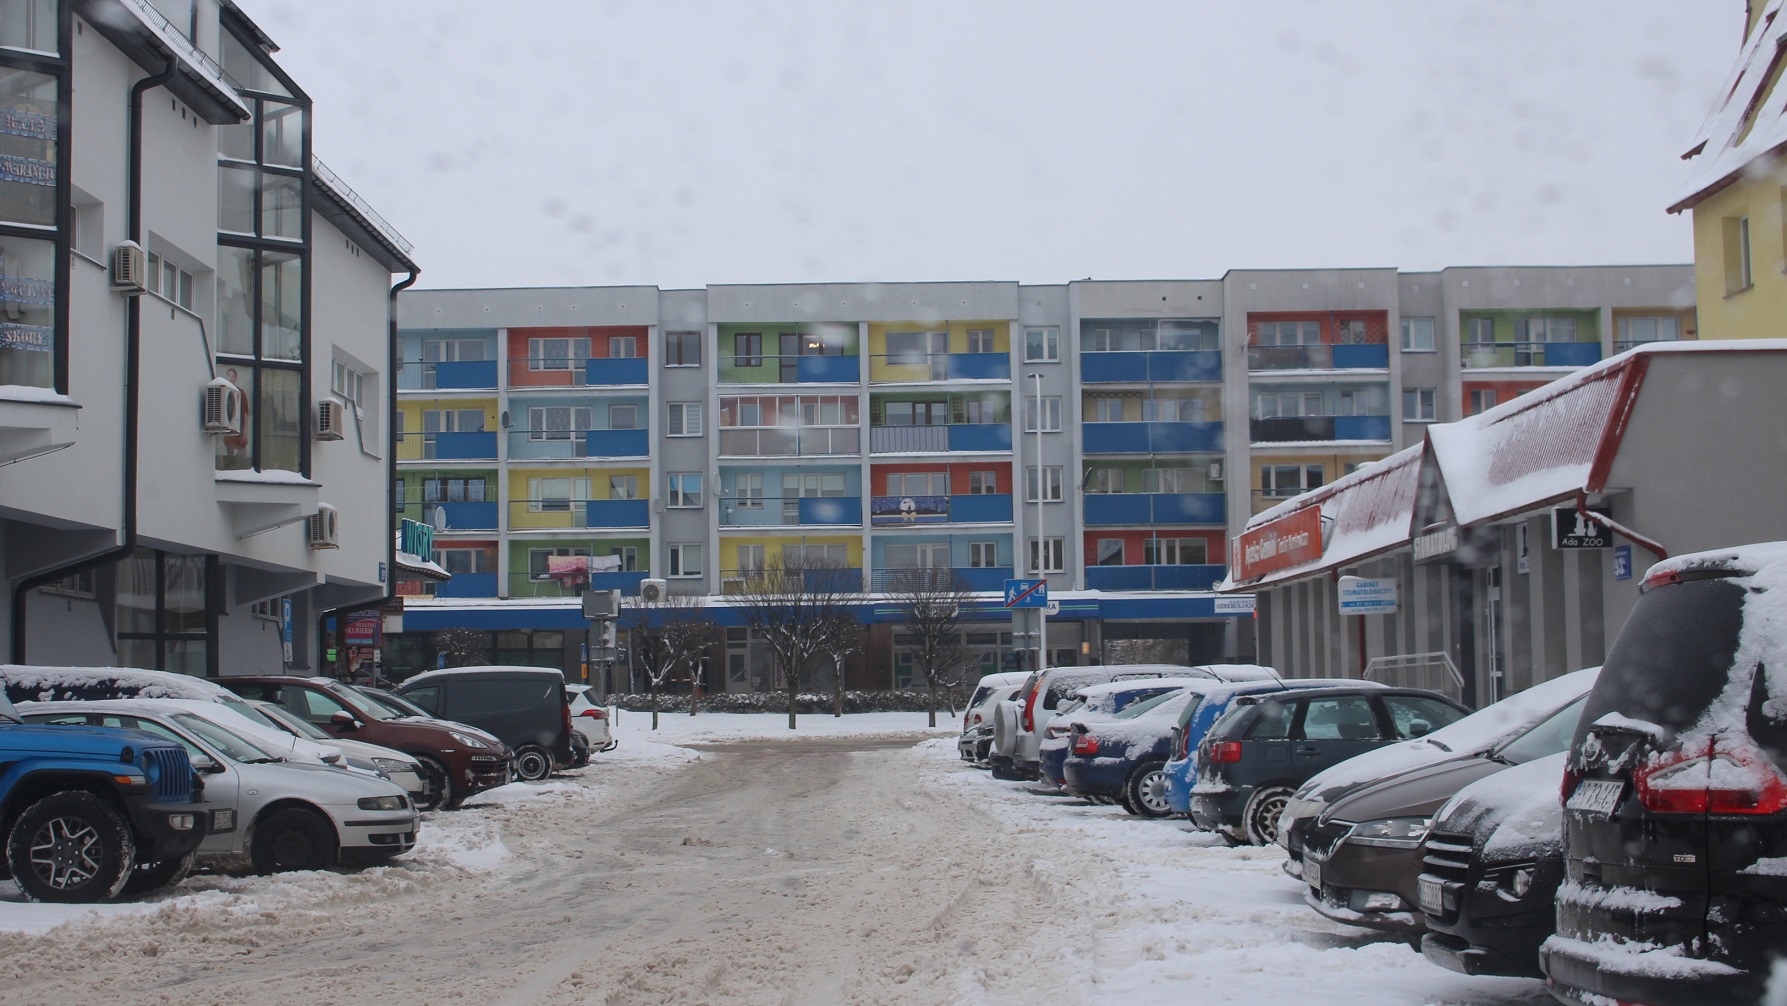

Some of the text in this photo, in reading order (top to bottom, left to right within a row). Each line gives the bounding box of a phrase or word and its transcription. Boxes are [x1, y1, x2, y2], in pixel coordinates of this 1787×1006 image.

[1562, 537, 1604, 546] Ada ZOO
[1342, 588, 1393, 596] STOMATOLOGICZNY
